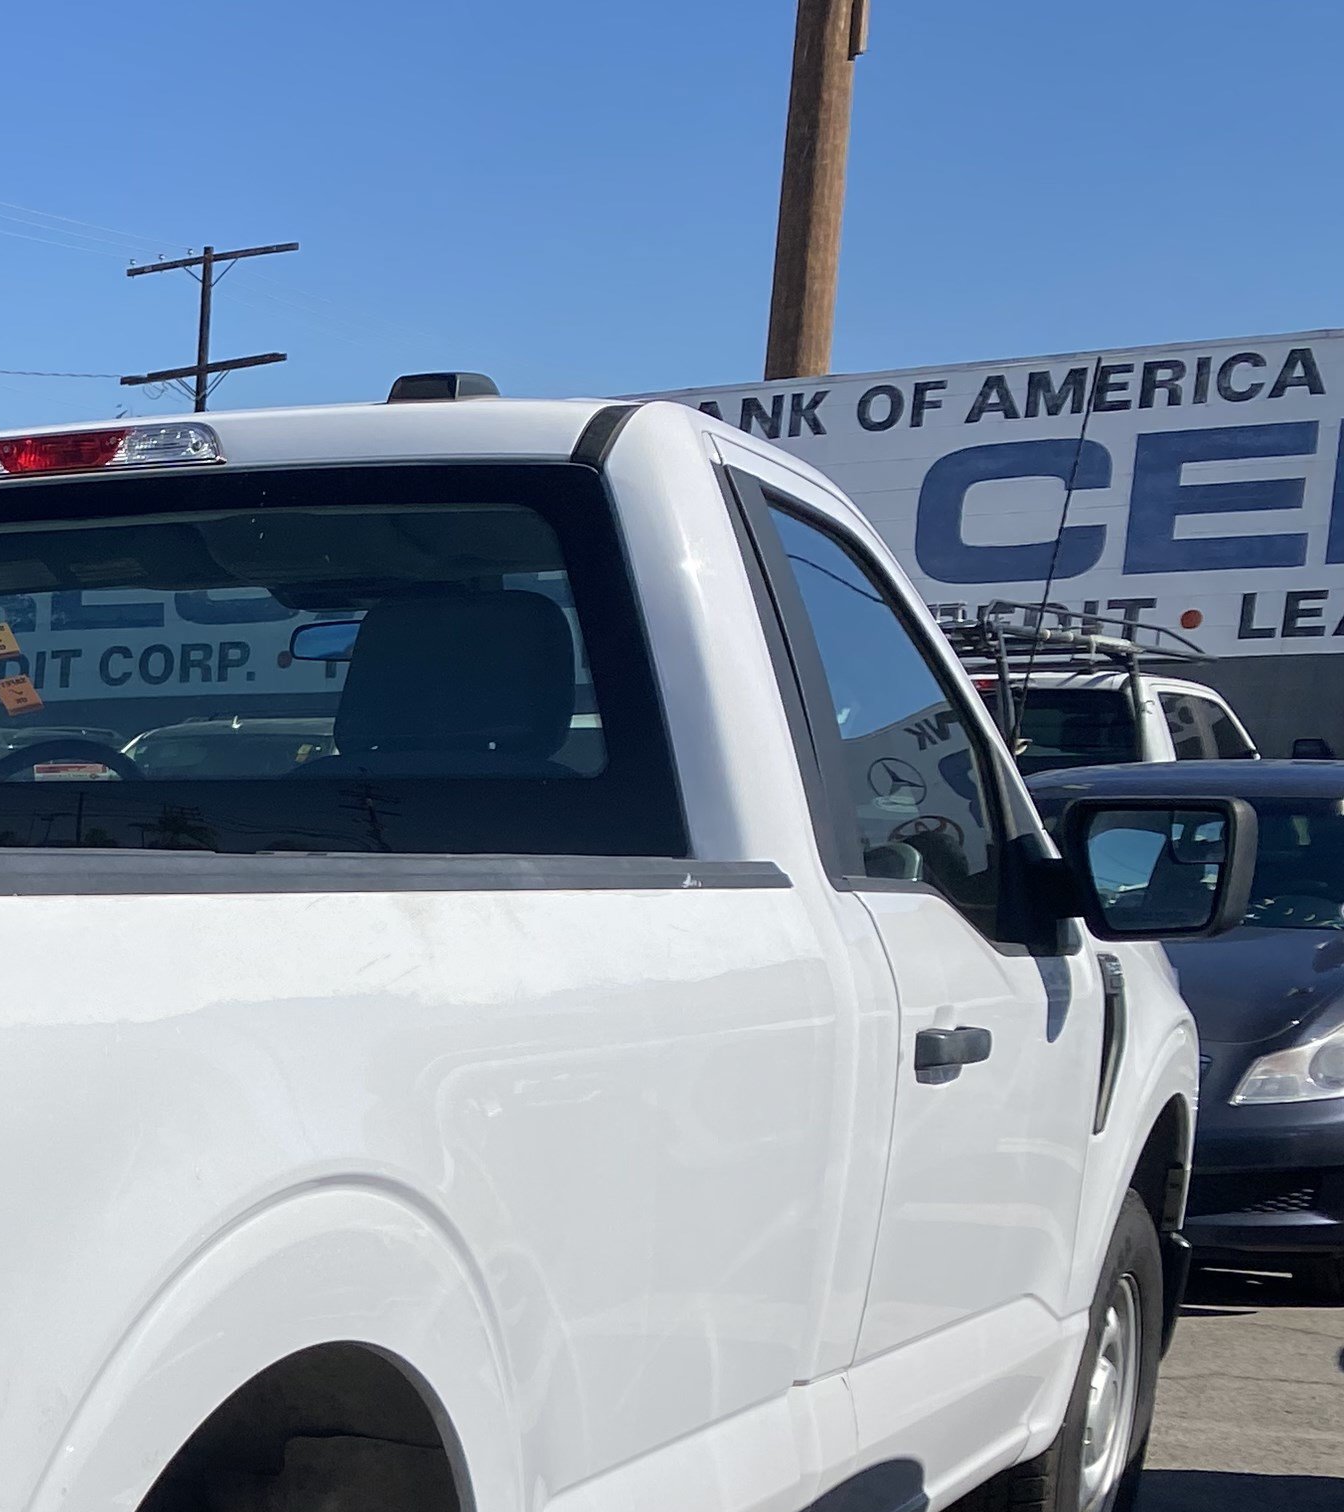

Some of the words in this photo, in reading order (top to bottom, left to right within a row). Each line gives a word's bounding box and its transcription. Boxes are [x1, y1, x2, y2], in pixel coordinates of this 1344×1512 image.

[856, 380, 947, 431] OF
[964, 347, 1326, 423] AMERICA
[915, 420, 1344, 584] CE
[1238, 590, 1344, 639] LE
[99, 641, 256, 688] CORP.
